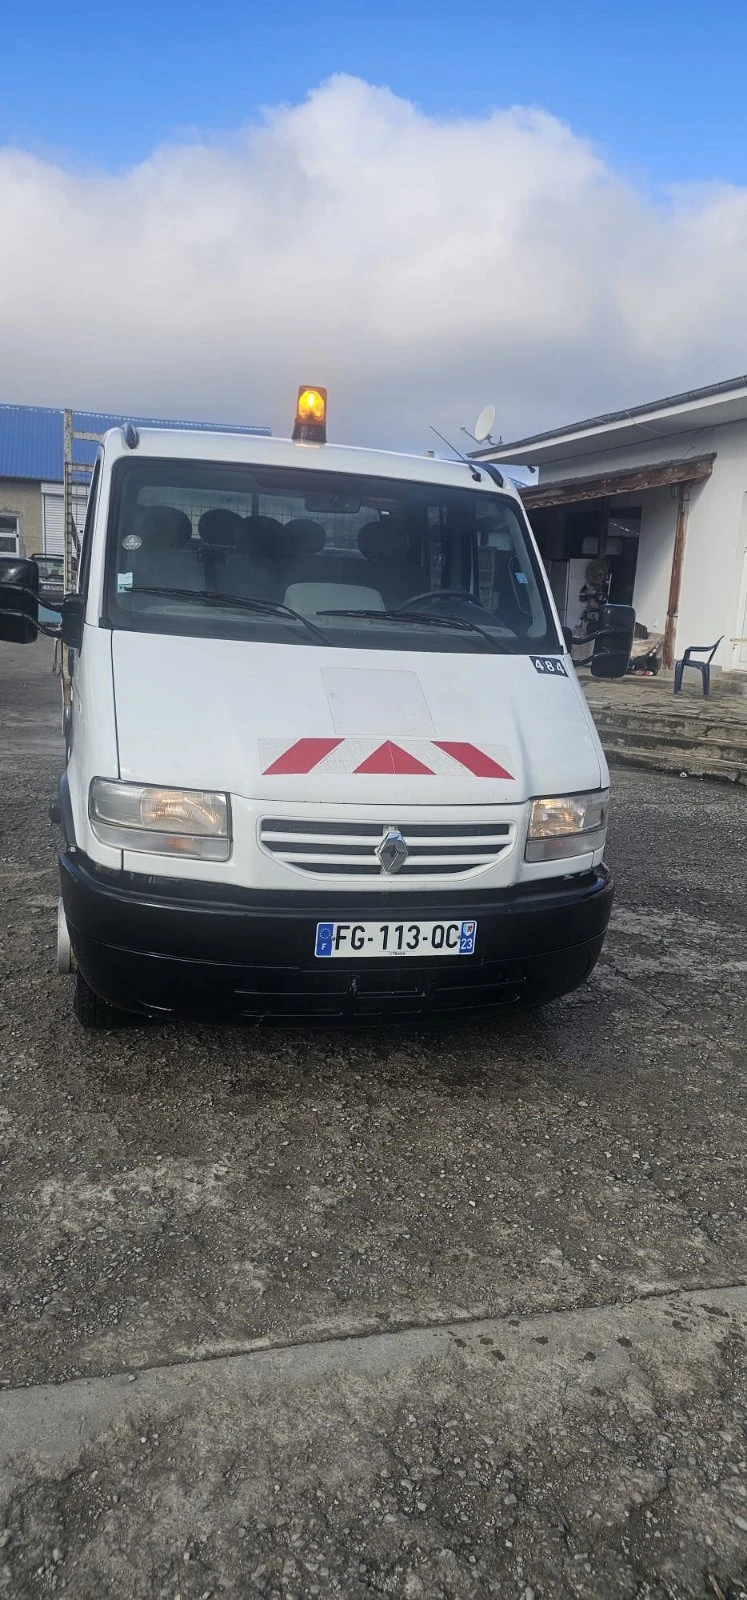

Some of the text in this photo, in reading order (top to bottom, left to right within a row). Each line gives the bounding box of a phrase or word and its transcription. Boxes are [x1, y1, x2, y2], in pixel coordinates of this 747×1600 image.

[535, 659, 565, 673] 484
[321, 943, 327, 951] F
[460, 938, 473, 950] 23
